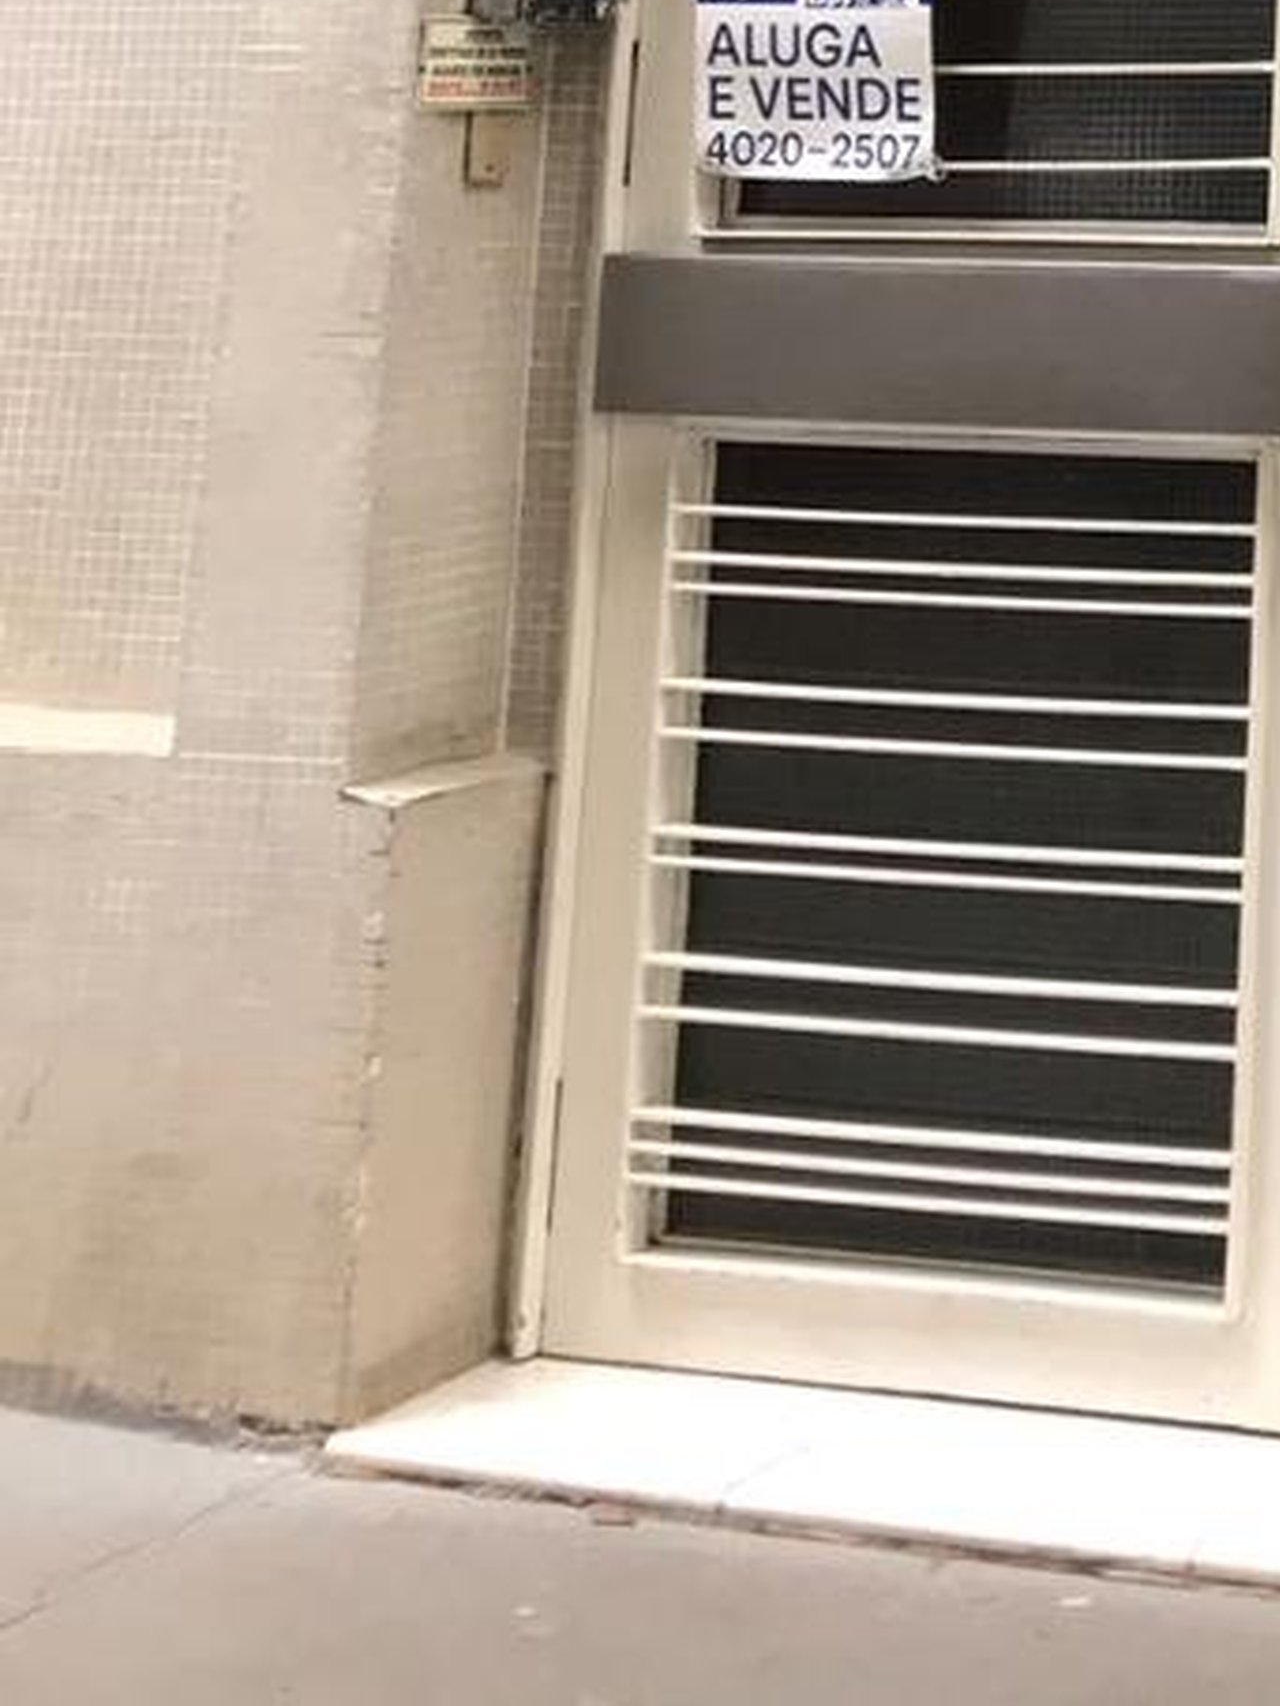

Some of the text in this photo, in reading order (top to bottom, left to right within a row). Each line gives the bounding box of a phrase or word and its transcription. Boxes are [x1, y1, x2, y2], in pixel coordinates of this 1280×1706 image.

[706, 22, 882, 68] ALUGA
[709, 75, 923, 122] E VENDE
[705, 130, 923, 171] 4020-2507
